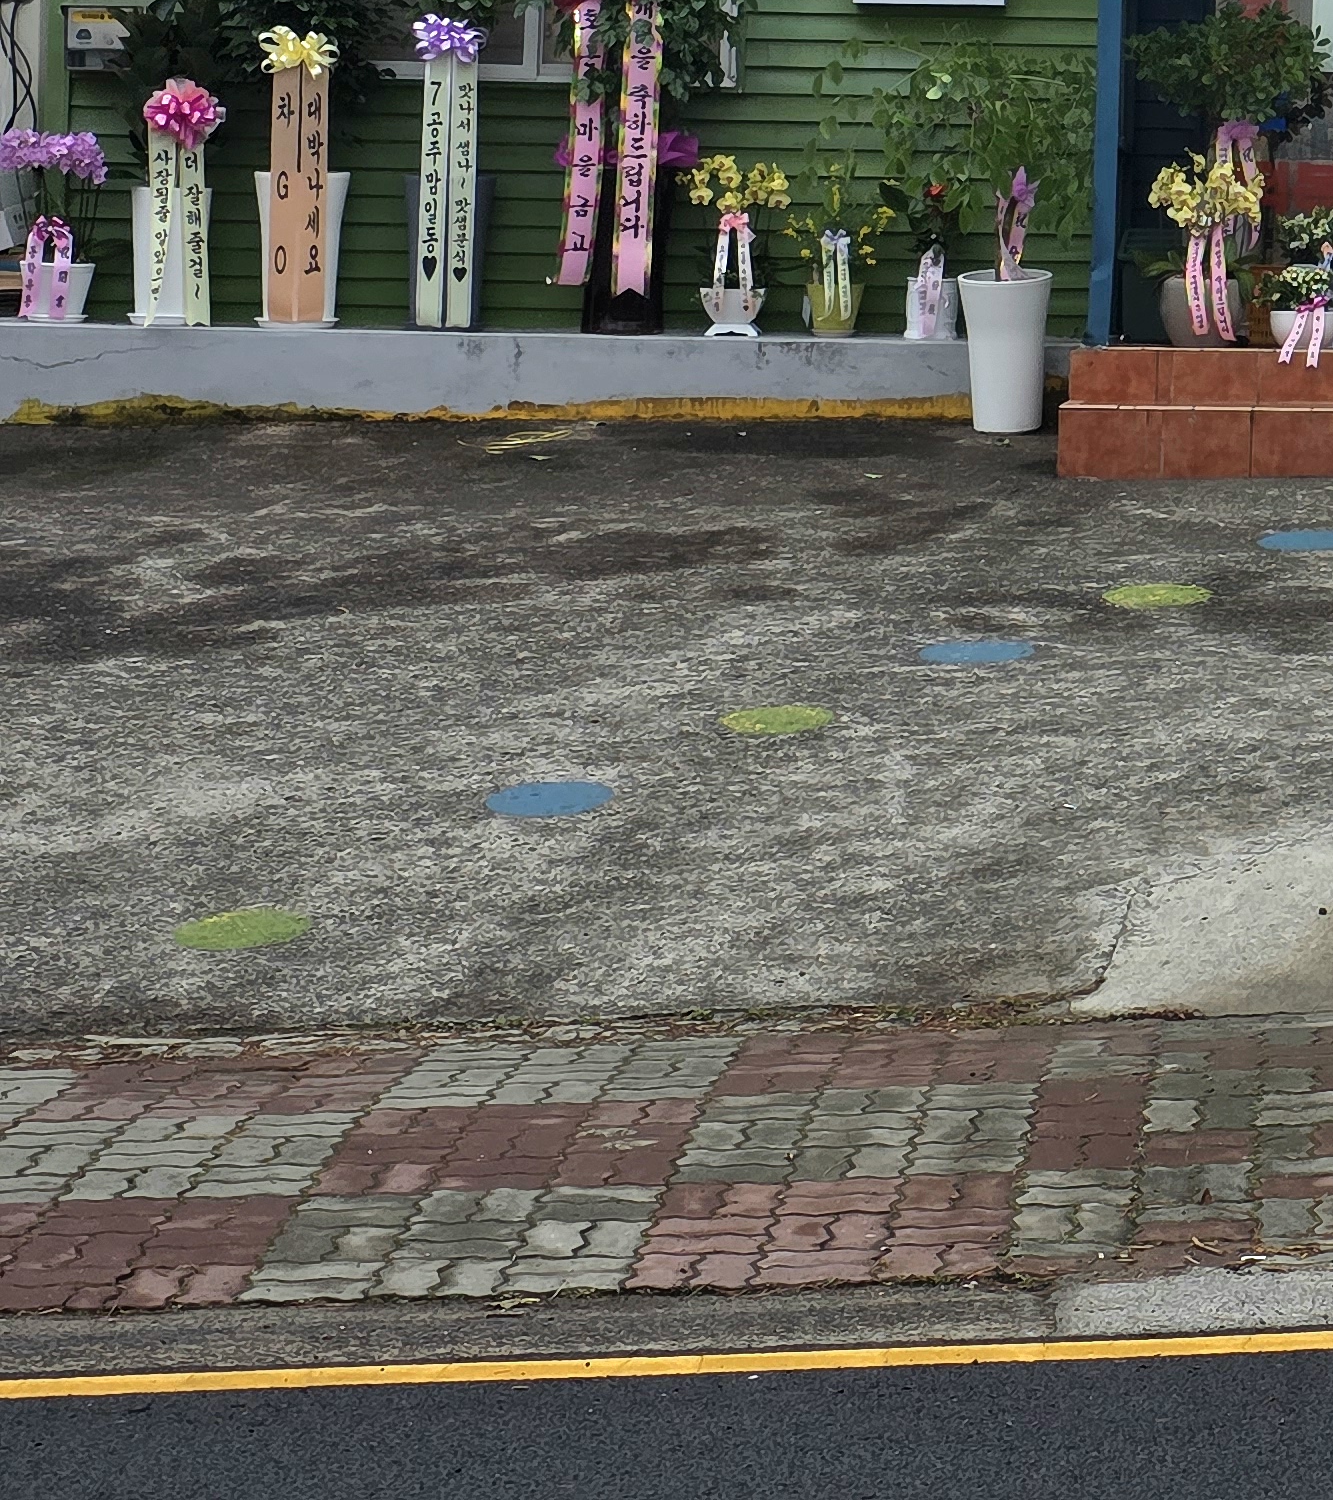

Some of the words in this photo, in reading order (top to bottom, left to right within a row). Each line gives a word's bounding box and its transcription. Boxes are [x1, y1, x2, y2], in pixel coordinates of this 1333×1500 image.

[631, 0, 655, 70] 개을
[457, 83, 475, 133] 맛나서
[185, 152, 198, 173] 더
[304, 92, 324, 275] 대박나세요
